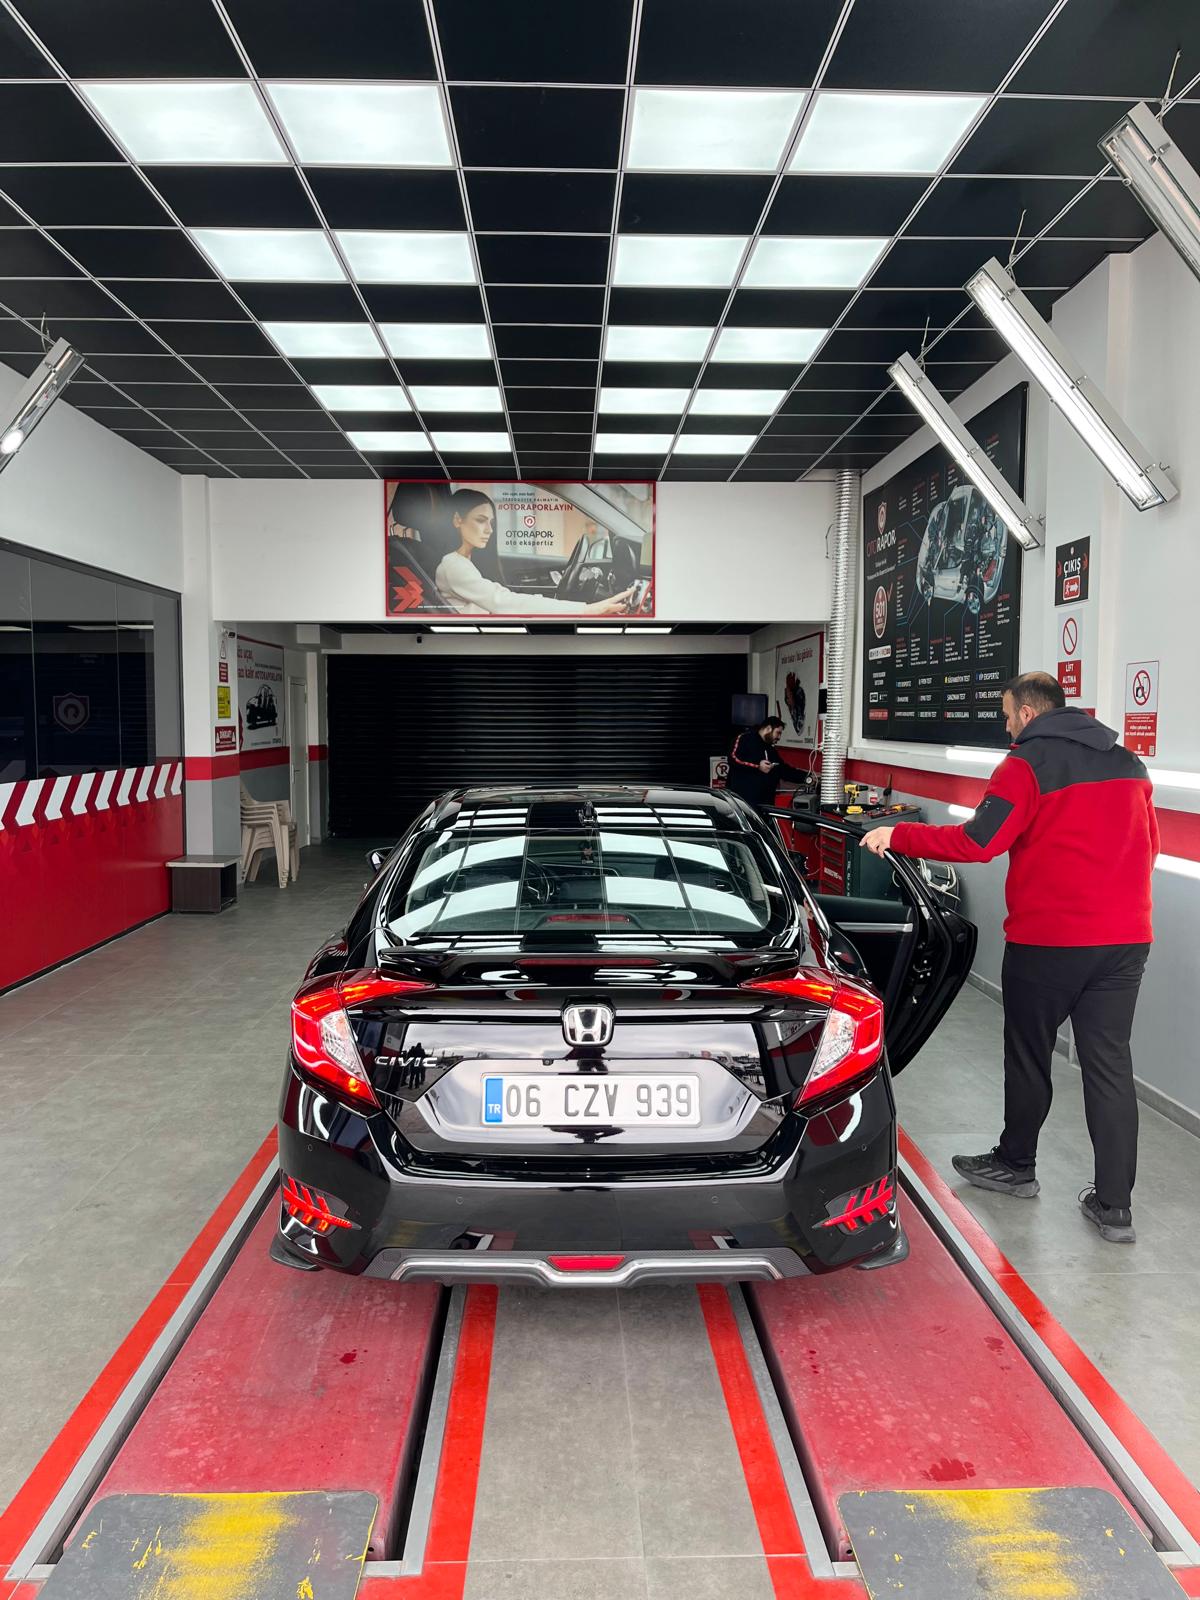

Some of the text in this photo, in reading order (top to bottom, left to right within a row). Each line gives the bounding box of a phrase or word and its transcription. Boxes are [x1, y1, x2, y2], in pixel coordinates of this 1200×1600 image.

[498, 503, 573, 511] #OTORAPORLAYIN
[505, 530, 554, 538] OTORAPOR
[1064, 557, 1081, 577] ÇIKIŞ
[875, 601, 885, 619] 501
[374, 1055, 438, 1068] CIVIC
[488, 1083, 693, 1118] TR 06 CZV 939
